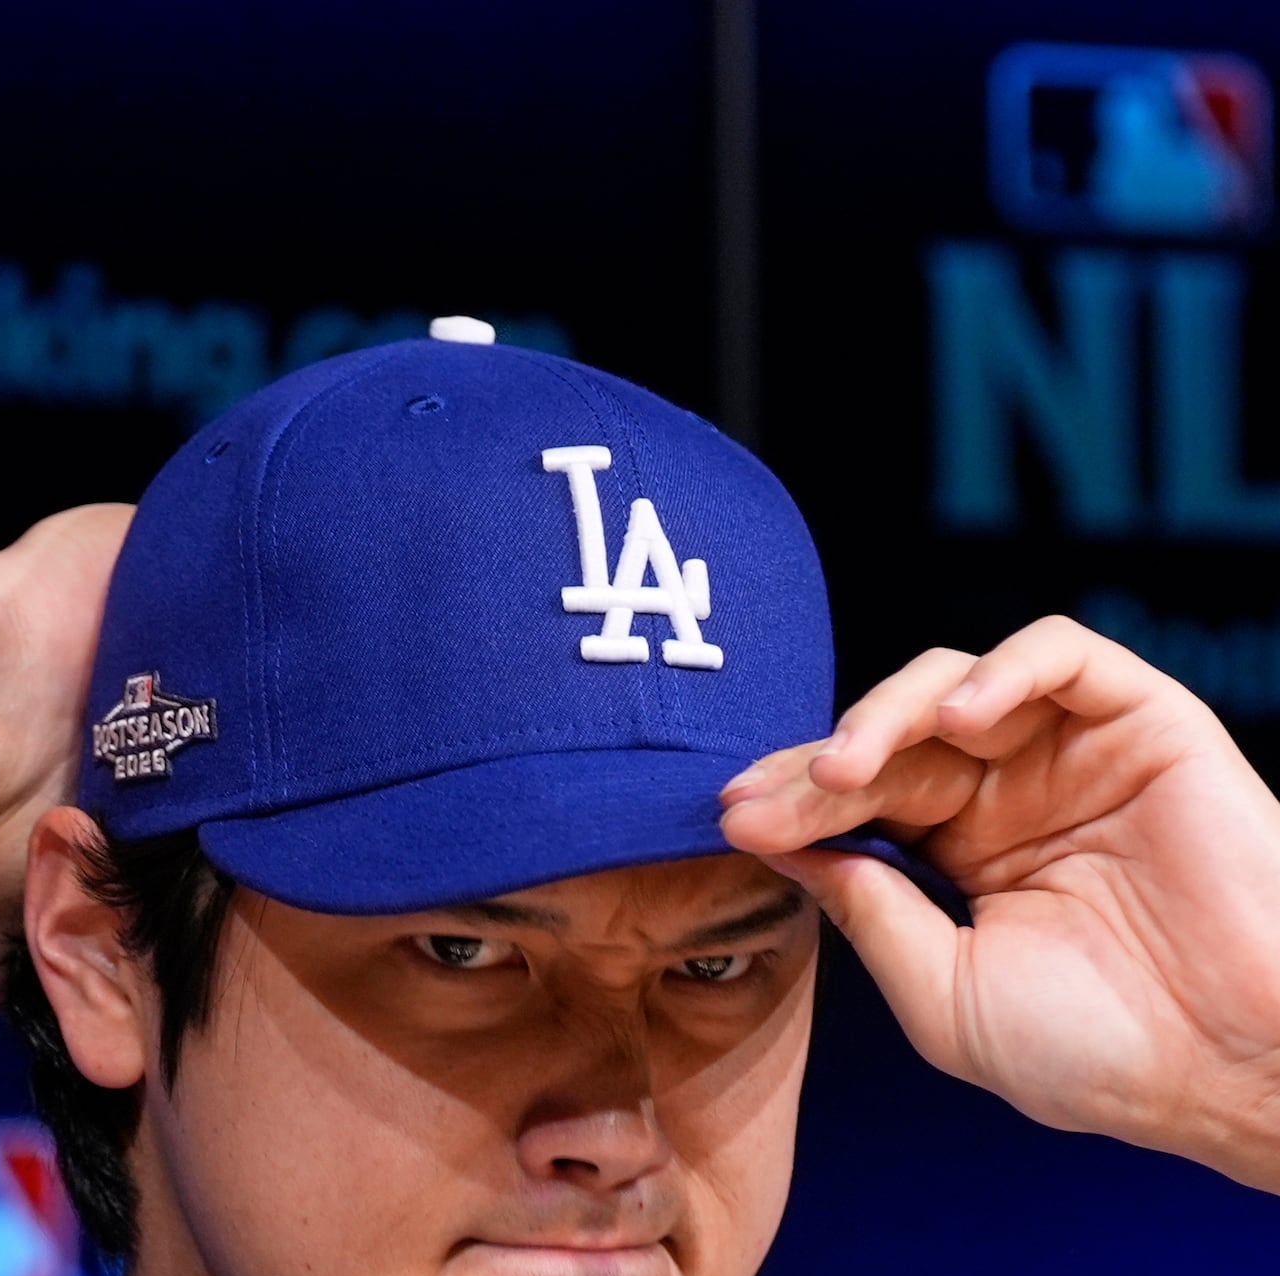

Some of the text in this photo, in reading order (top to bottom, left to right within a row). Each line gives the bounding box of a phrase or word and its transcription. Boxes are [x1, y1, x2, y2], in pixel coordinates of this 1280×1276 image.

[541, 444, 724, 670] LA
[93, 704, 211, 758] POSTSEASON
[114, 748, 167, 780] 2026
